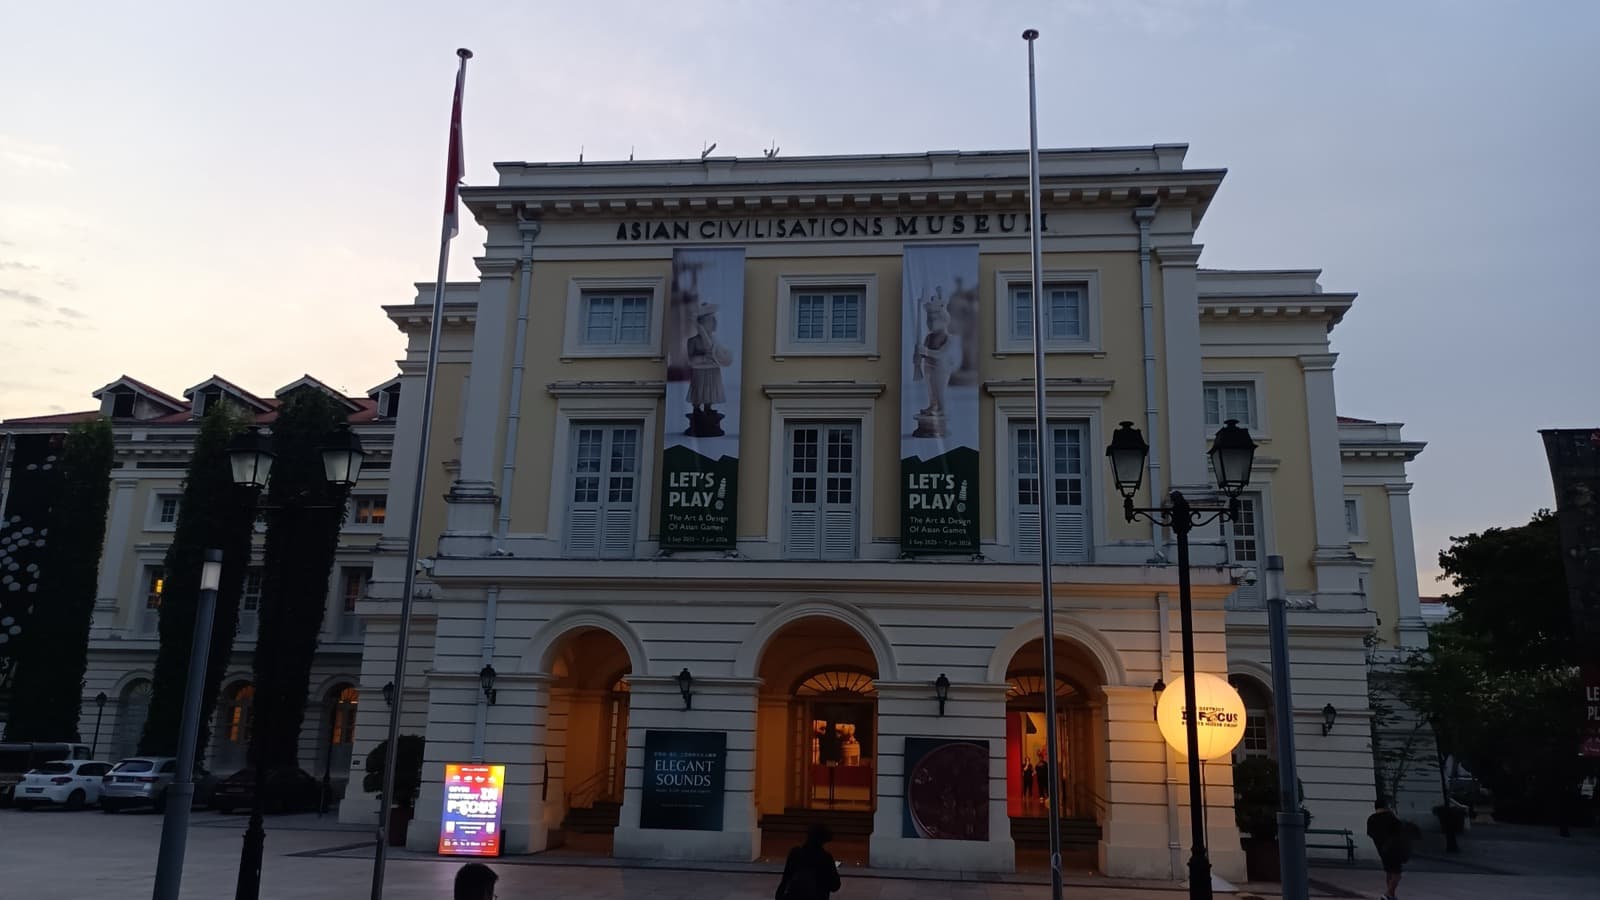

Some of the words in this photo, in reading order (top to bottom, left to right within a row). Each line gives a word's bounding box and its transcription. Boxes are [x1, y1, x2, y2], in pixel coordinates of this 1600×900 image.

[616, 221, 690, 241] ASIAN
[699, 217, 884, 239] CIVILISATIONS
[669, 472, 714, 487] LET'S
[909, 474, 955, 489] LET'S
[909, 516, 923, 524] The
[655, 759, 715, 773] ELEGANT
[655, 773, 712, 787] SOUNDS
